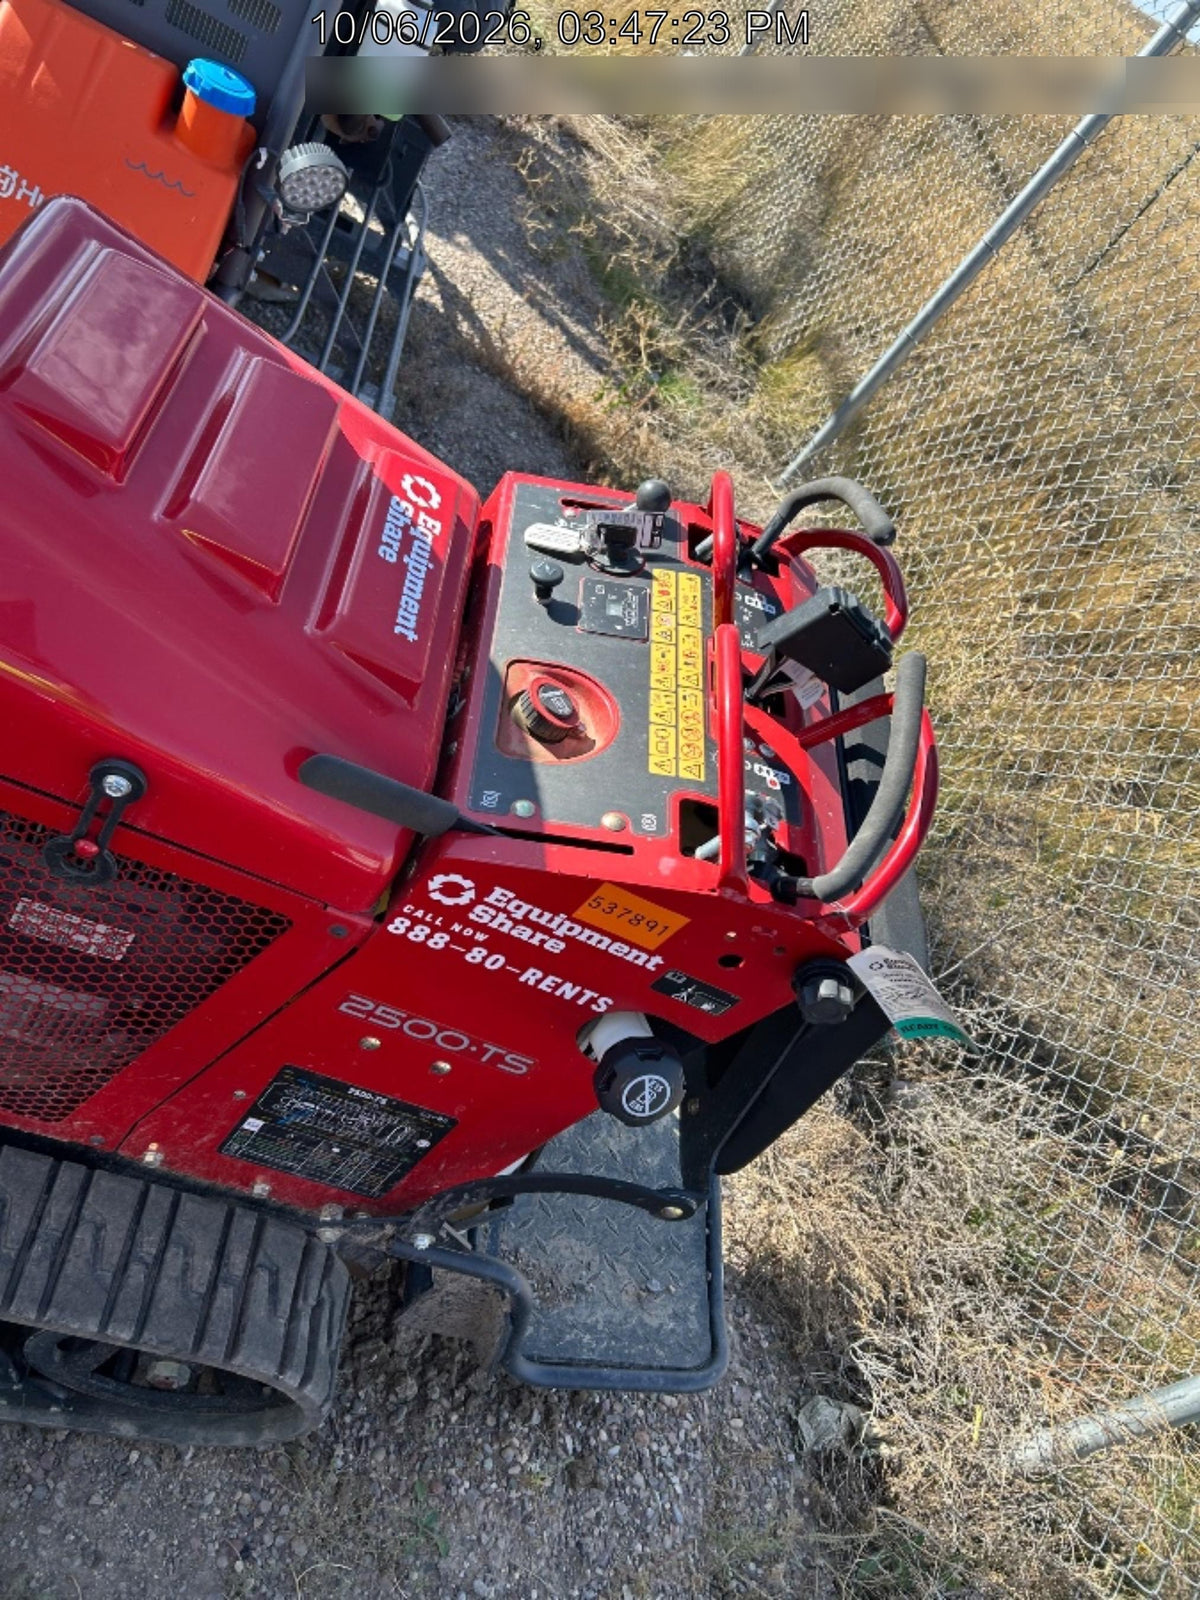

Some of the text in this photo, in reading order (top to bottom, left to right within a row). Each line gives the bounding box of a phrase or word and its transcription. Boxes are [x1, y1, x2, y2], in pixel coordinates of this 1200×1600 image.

[378, 495, 414, 564] Share
[394, 511, 442, 643] Equipment
[403, 904, 490, 942] CALL NOW
[468, 904, 567, 954] Share
[483, 886, 666, 971] Equipment
[587, 895, 671, 938] 537891
[387, 917, 615, 1013] 888-80-RENTS
